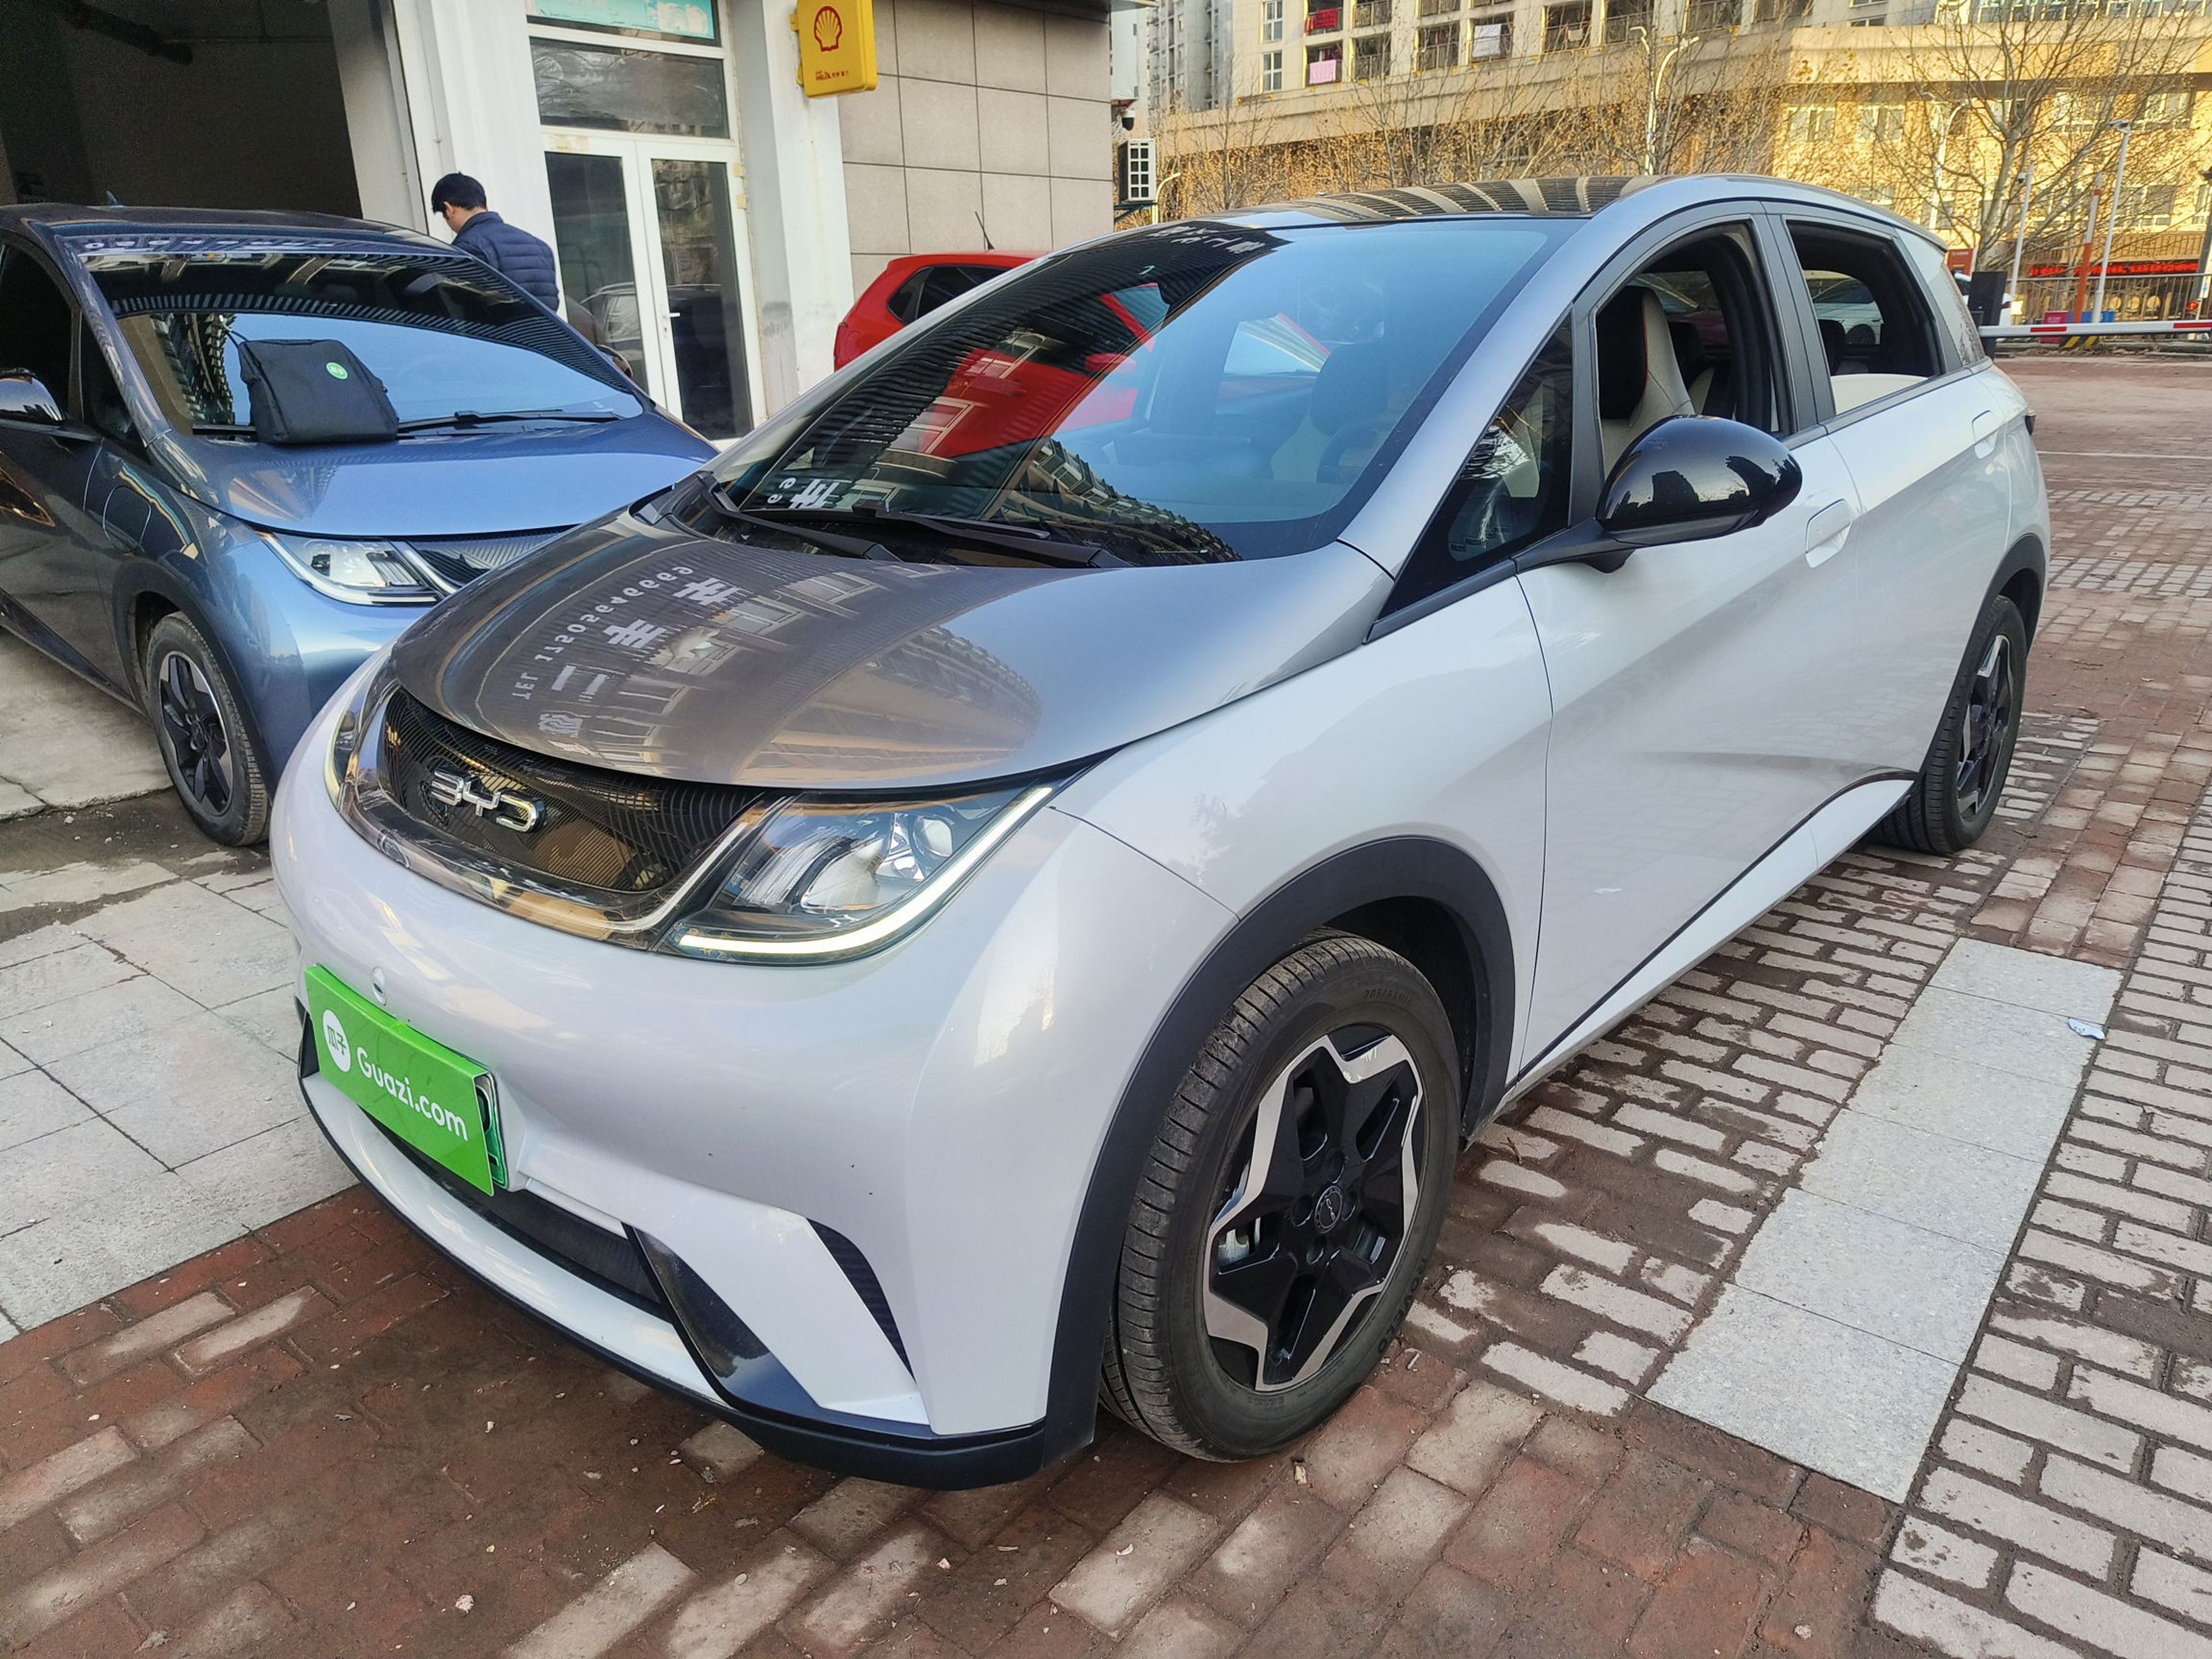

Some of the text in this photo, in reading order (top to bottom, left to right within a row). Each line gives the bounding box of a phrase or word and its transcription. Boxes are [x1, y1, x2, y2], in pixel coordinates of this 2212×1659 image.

[430, 771, 537, 832] BYD
[327, 1025, 468, 1142] 瓜子 Guazi.com
